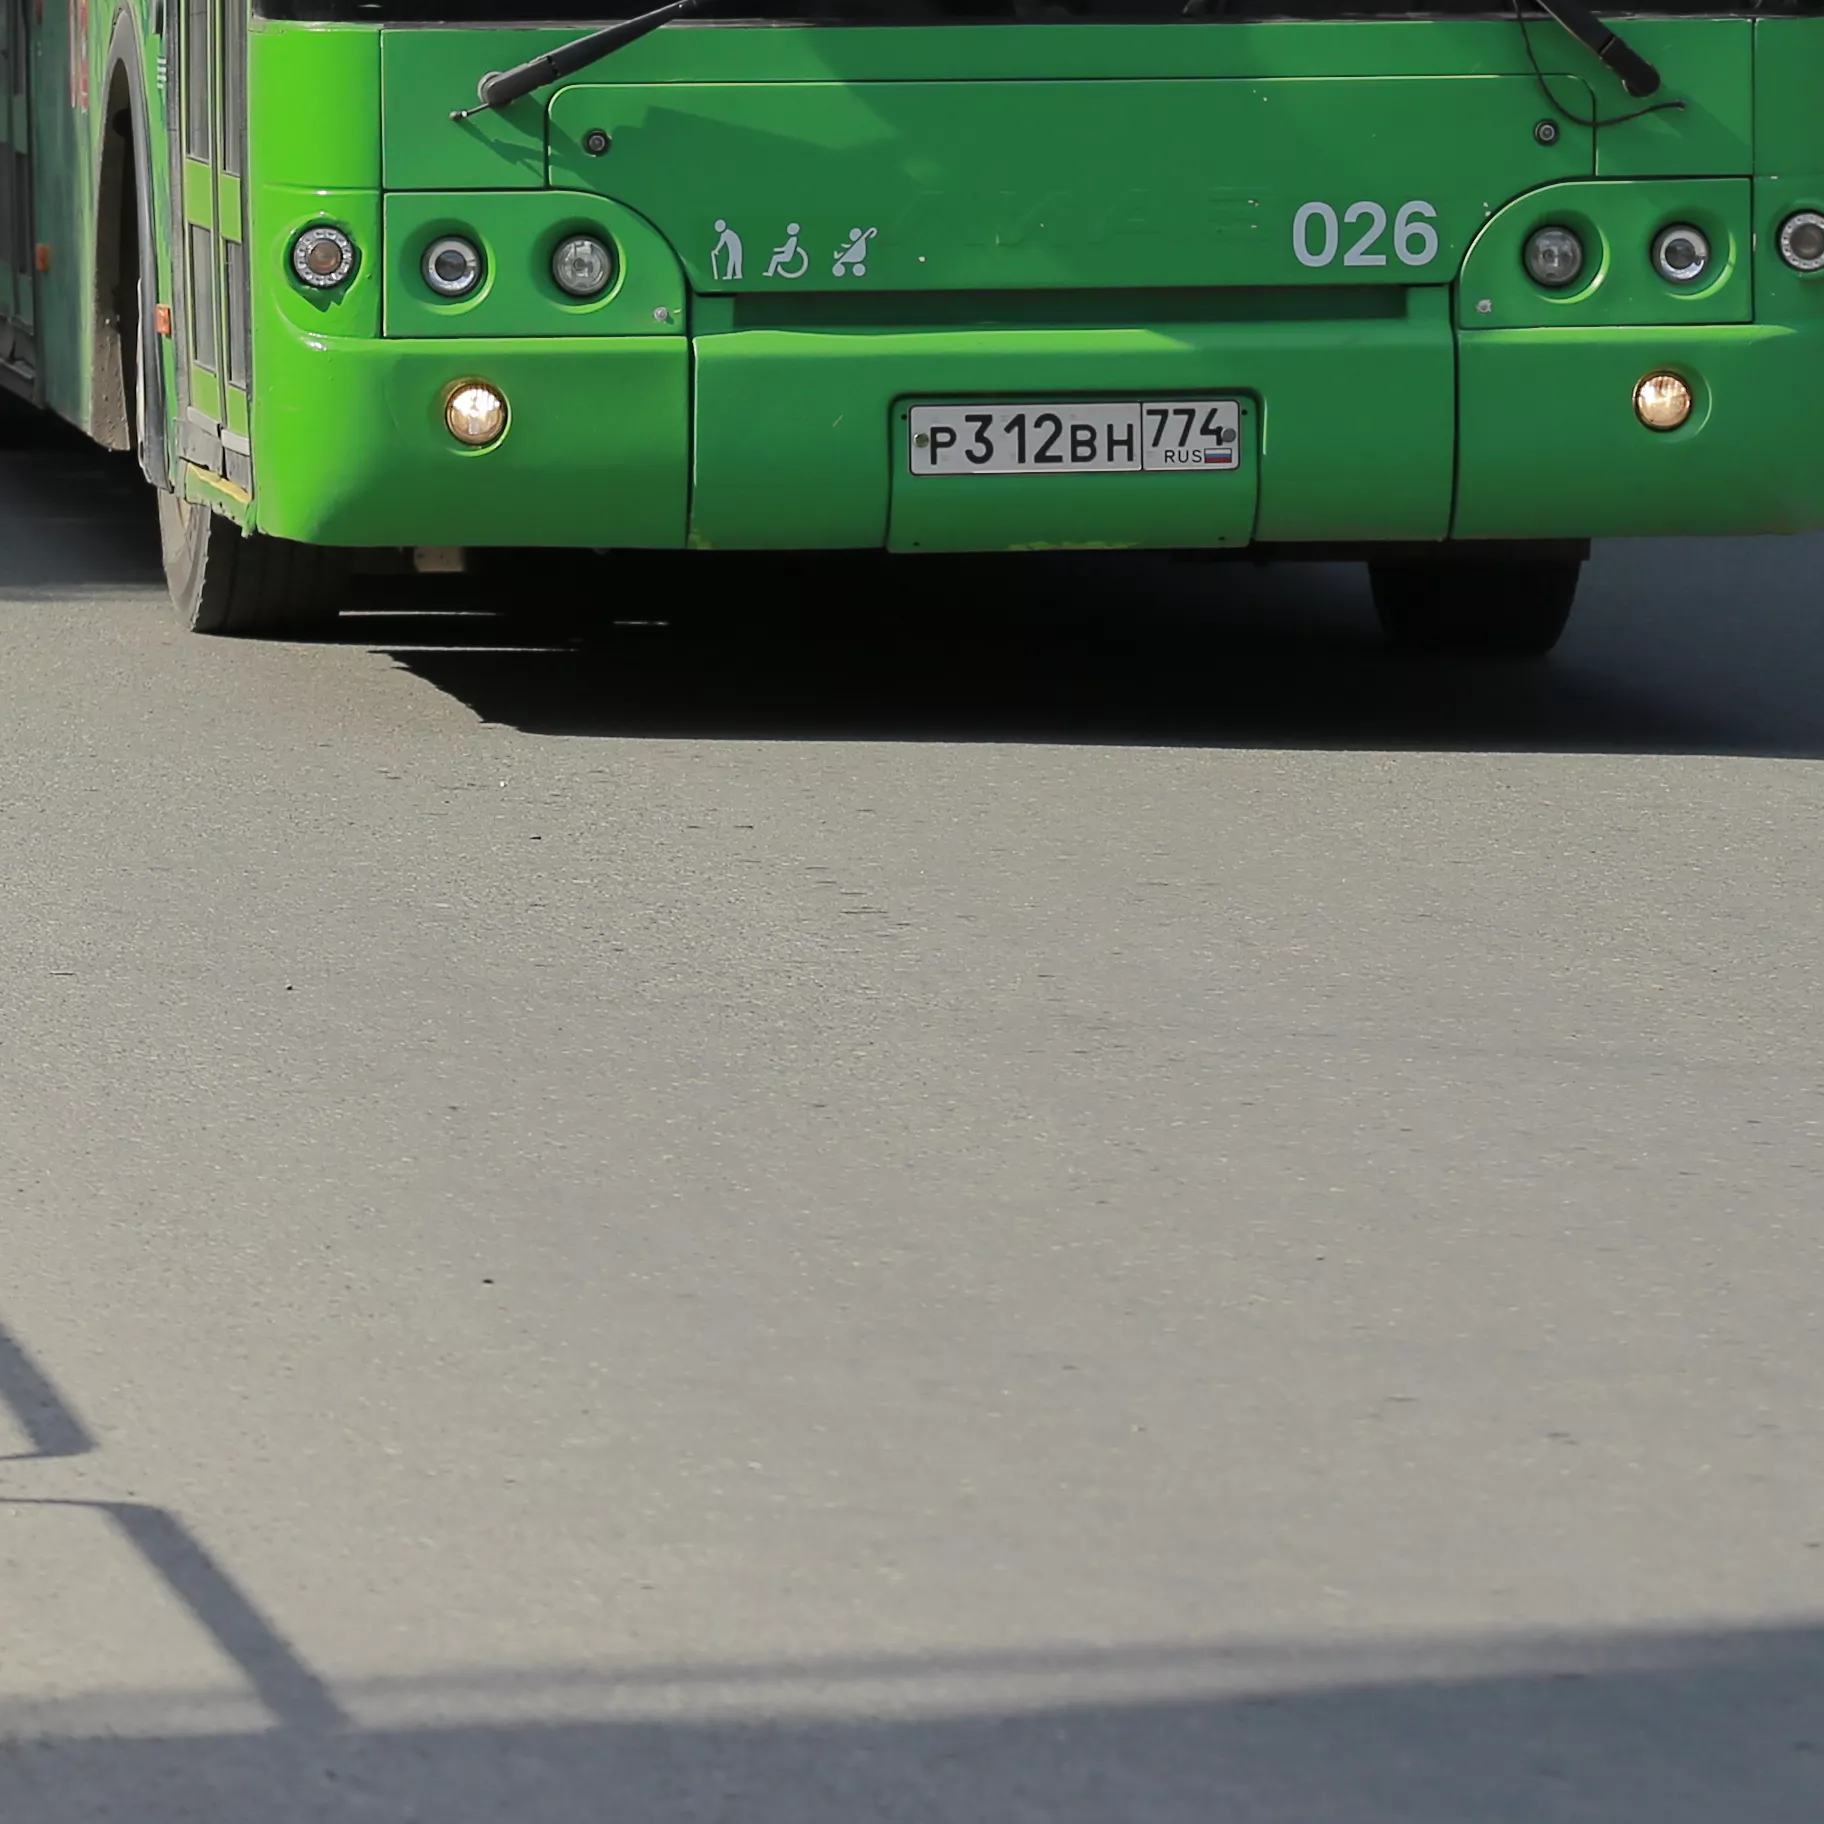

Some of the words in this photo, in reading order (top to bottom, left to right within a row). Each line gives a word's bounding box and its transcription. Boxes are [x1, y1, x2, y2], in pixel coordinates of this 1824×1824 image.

[1292, 200, 1439, 267] 026
[929, 412, 1134, 465] Р312ВН
[1145, 407, 1227, 448] 774
[1164, 449, 1203, 464] RUS
